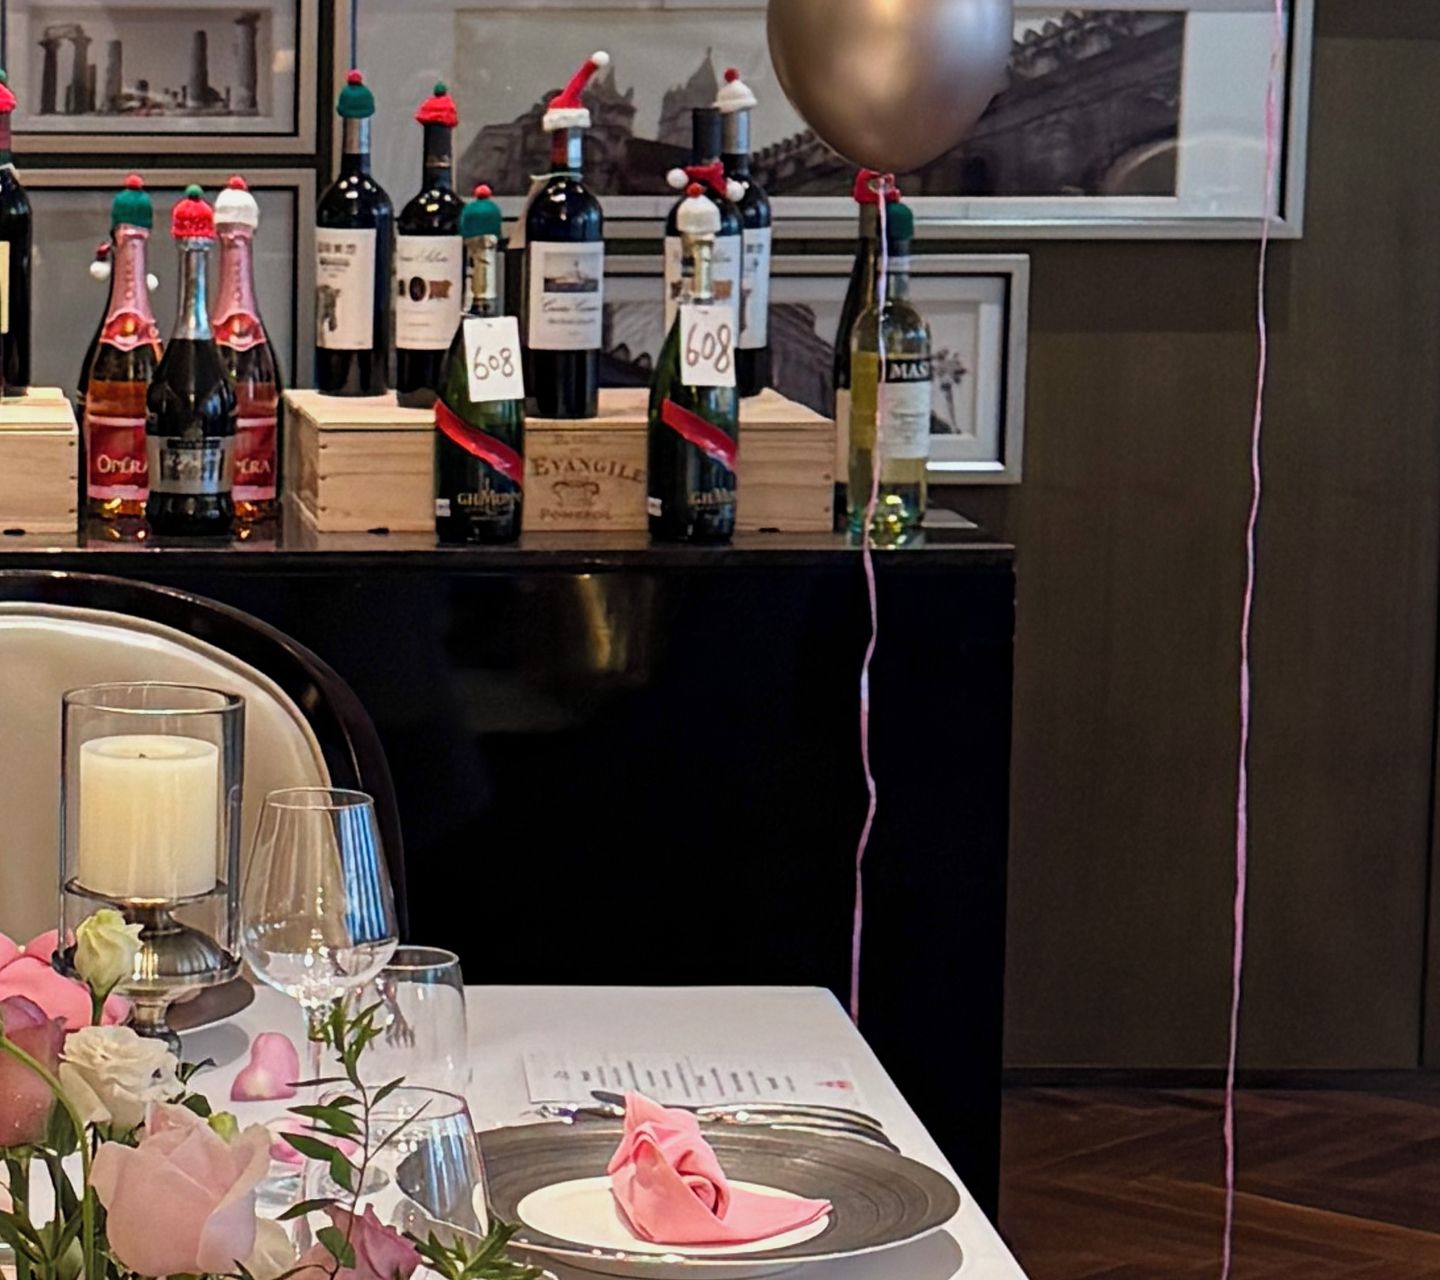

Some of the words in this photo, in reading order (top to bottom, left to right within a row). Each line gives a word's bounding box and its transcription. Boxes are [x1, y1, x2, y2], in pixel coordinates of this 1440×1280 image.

[473, 346, 515, 380] 608
[686, 323, 732, 373] 608
[889, 362, 929, 380] MAS
[531, 456, 644, 485] EVANGILE
